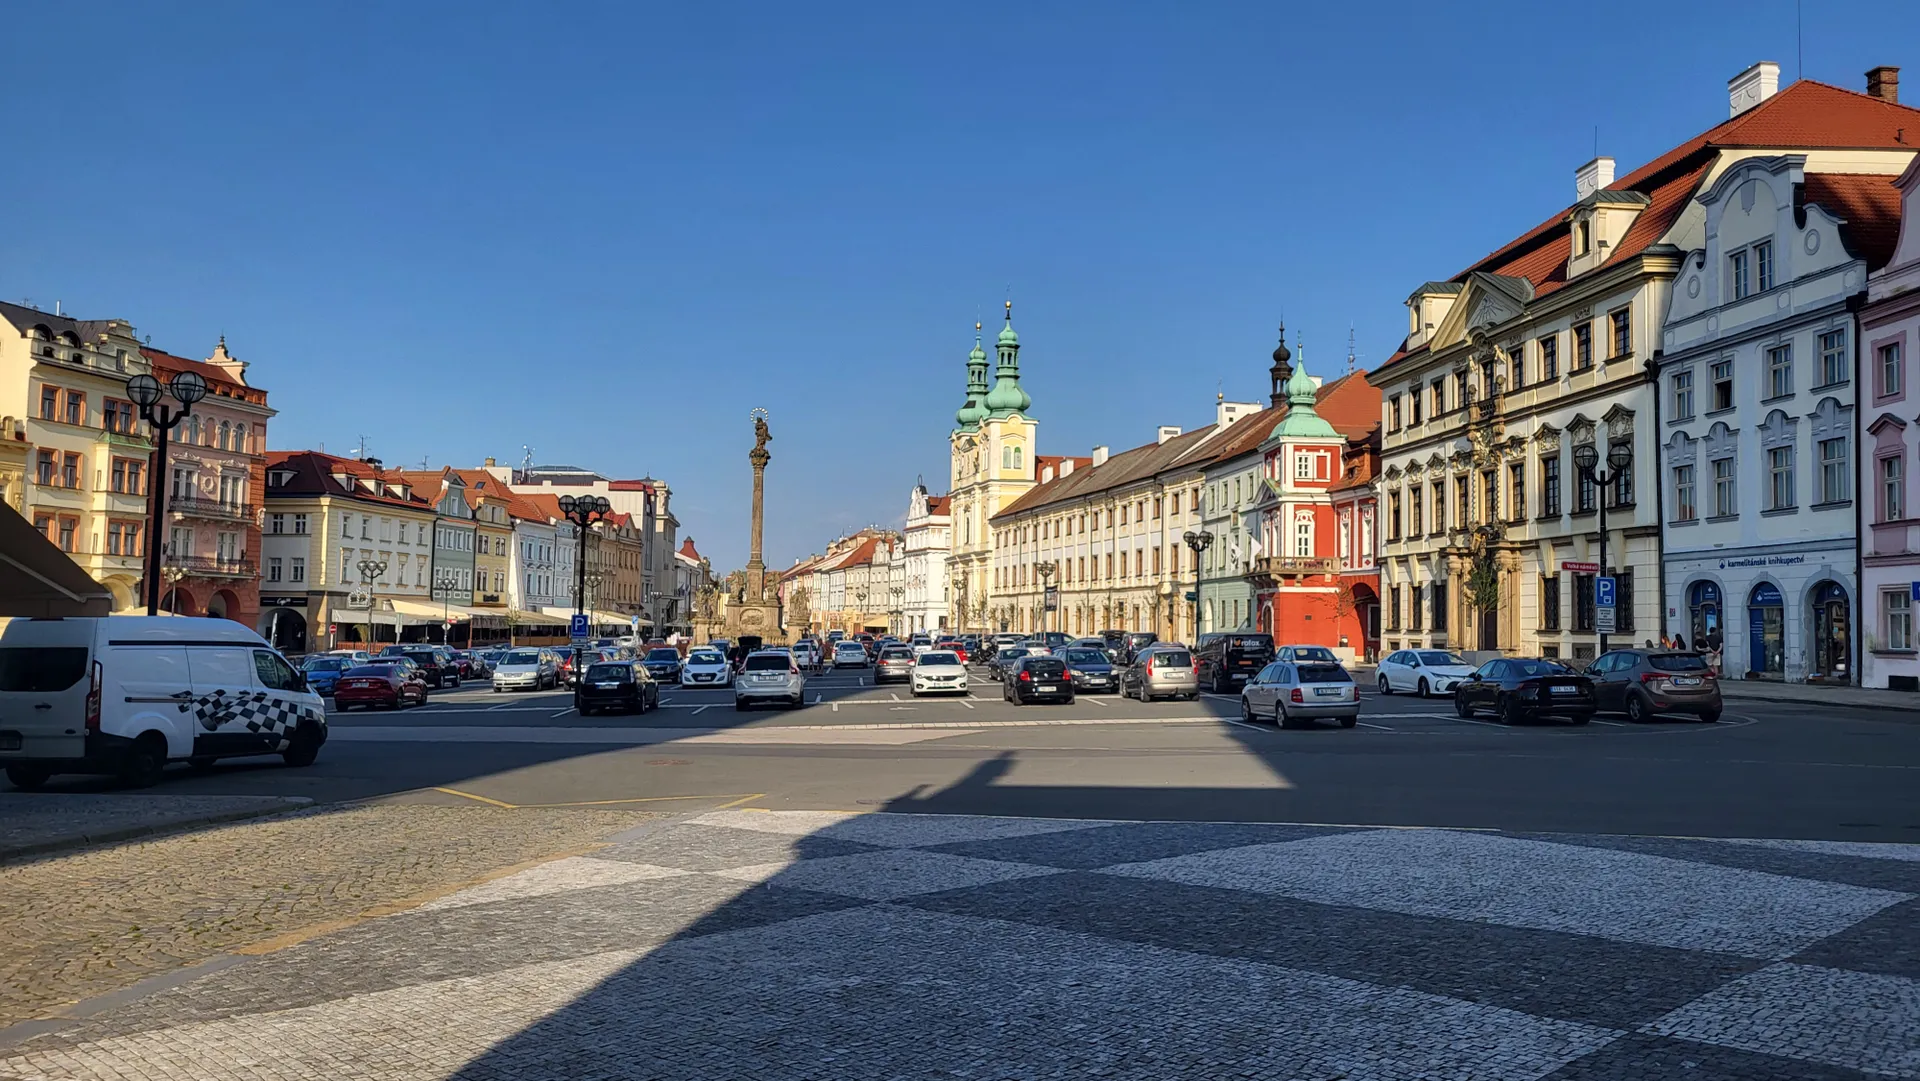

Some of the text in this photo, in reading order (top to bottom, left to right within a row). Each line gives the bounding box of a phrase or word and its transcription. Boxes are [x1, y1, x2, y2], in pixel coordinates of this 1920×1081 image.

[1727, 554, 1805, 567] karmelitánské knihkupectví
[1600, 581, 1611, 597] P
[574, 617, 585, 631] P
